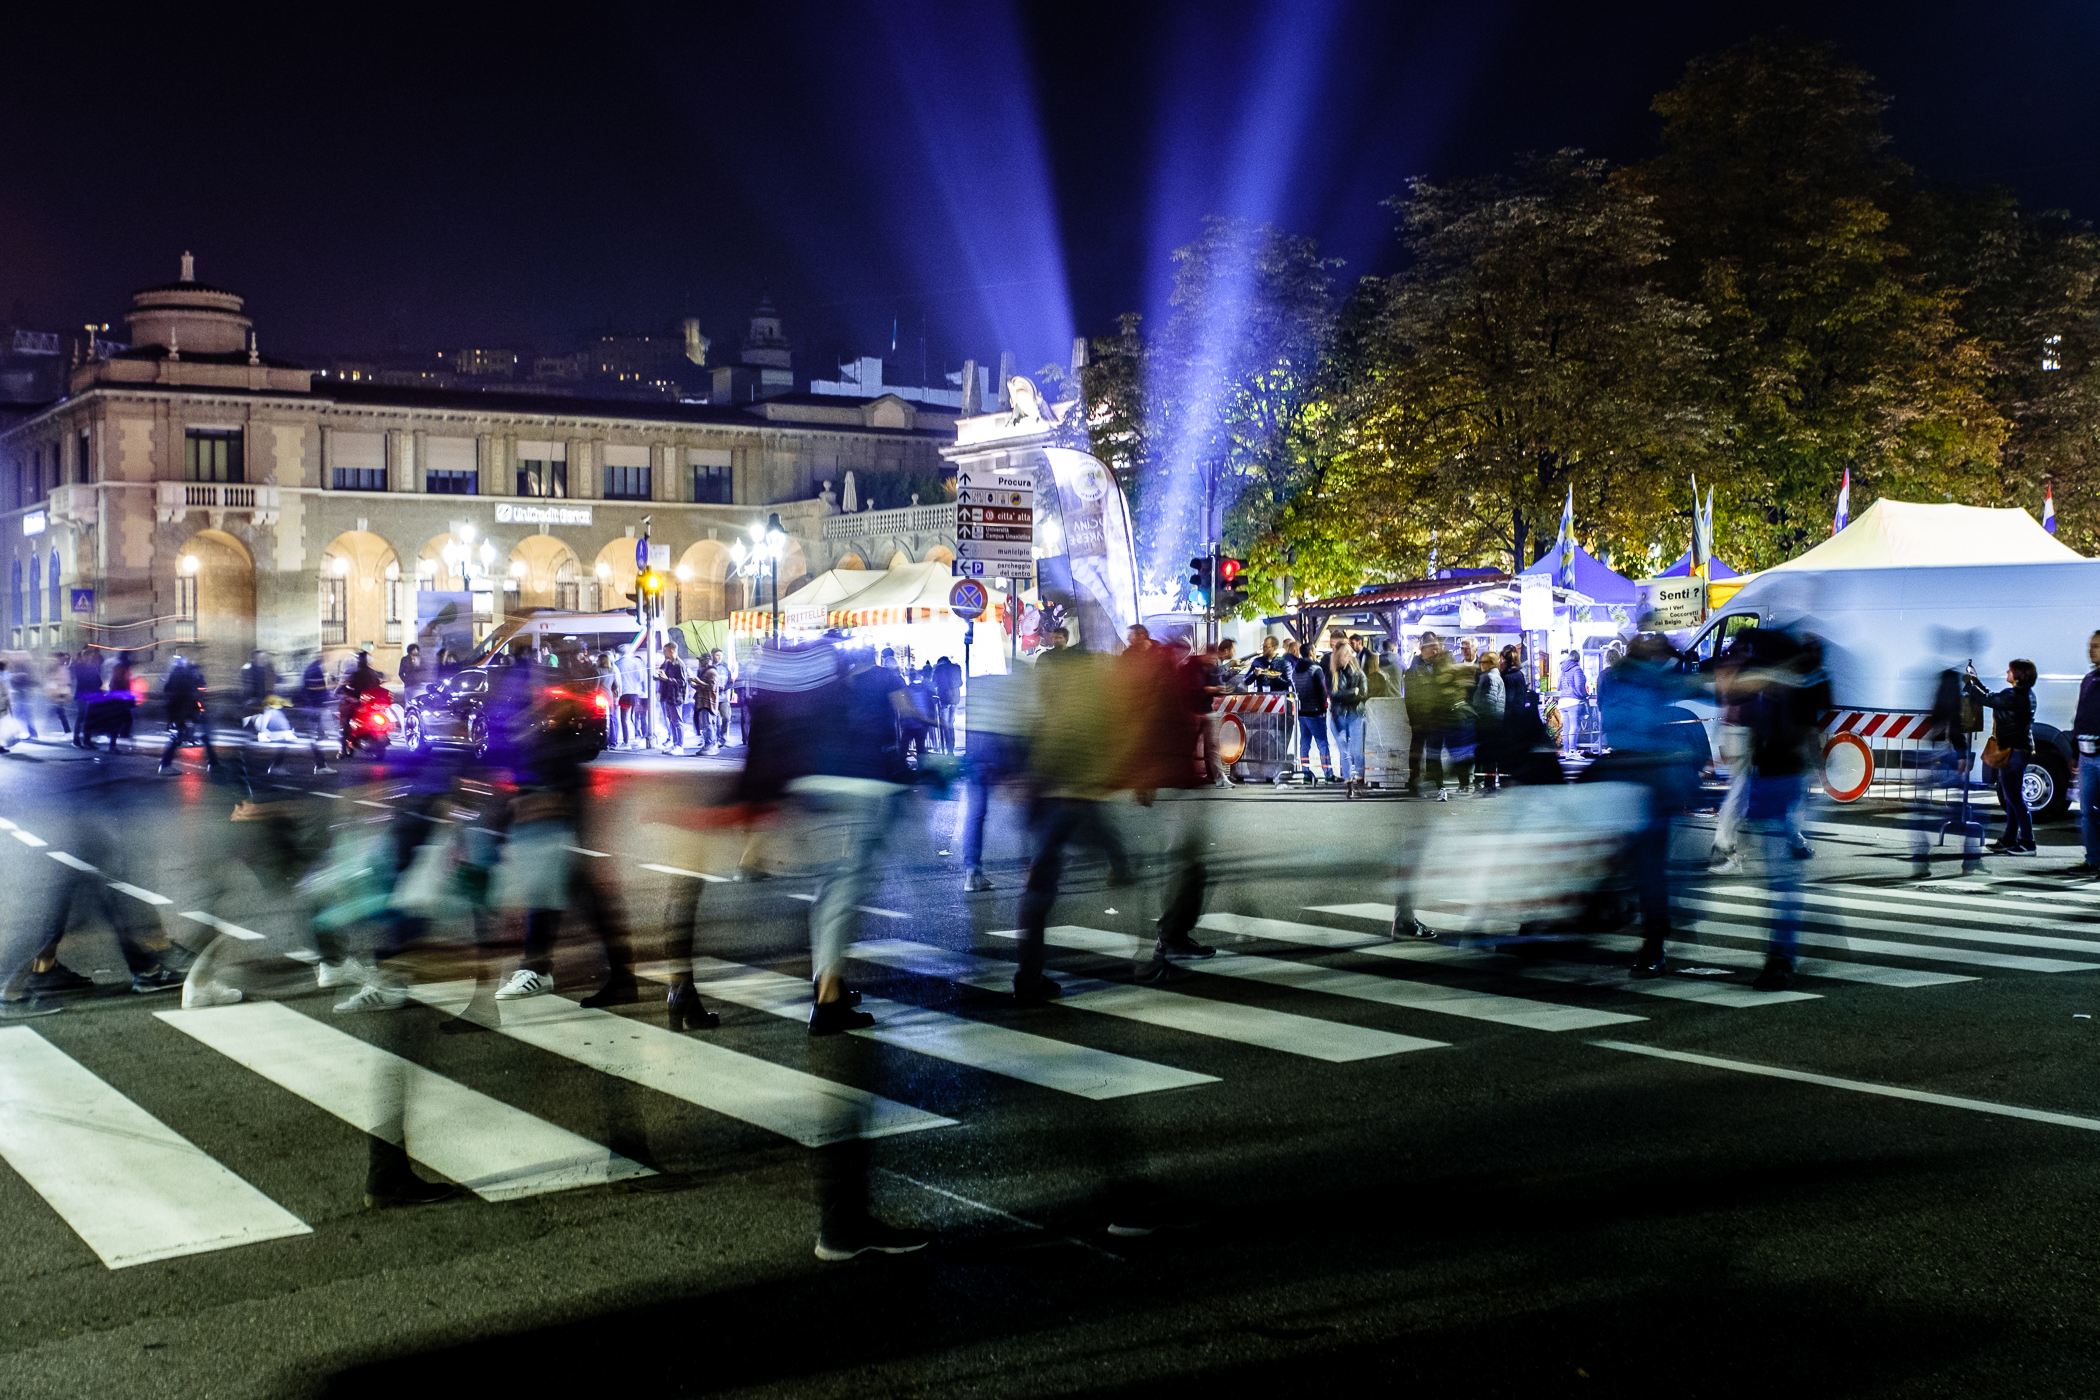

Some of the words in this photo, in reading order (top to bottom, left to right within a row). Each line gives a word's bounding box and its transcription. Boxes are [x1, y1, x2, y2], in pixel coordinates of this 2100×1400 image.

[998, 477, 1031, 487] Procura
[1017, 512, 1031, 522] alta
[997, 548, 1030, 556] municipio
[997, 562, 1031, 570] parcheggio
[1660, 588, 1690, 600] Senti
[1693, 588, 1700, 597] ?
[786, 607, 825, 624] FRITTELLE
